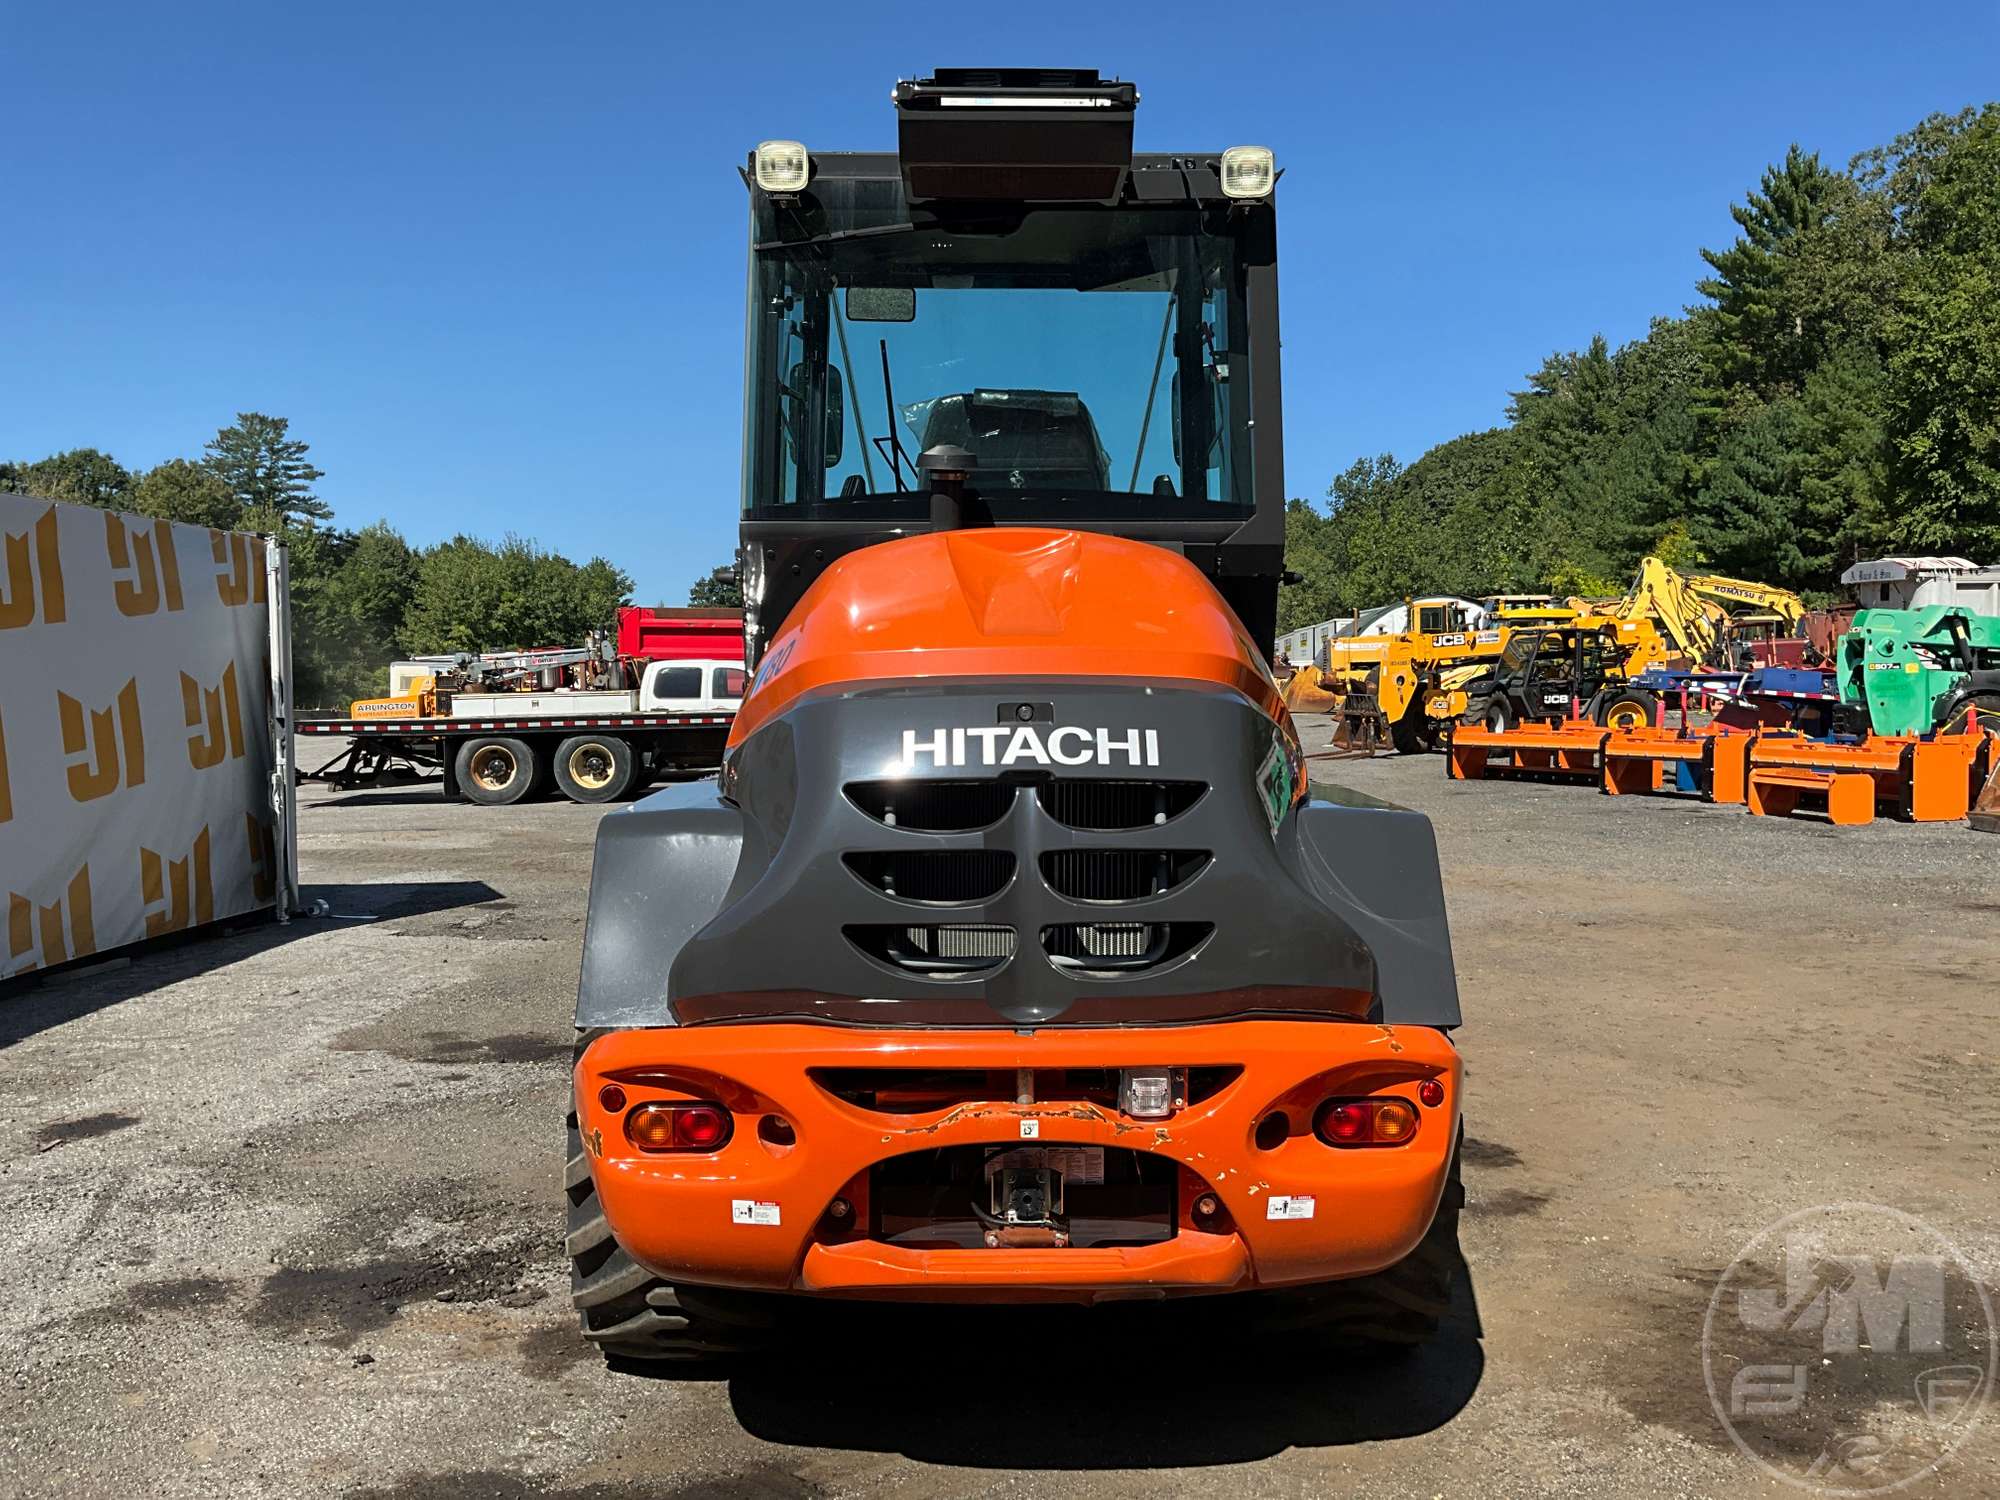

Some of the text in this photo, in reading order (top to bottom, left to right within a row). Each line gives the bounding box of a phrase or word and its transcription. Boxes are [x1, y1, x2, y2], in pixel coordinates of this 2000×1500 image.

[1714, 585, 1755, 598] KOMATSU
[1433, 634, 1465, 647] JCB
[1433, 701, 1448, 709] JCB
[1544, 695, 1568, 704] JCB
[357, 703, 415, 711] ARLINGTON
[902, 726, 1159, 767] HITACHI
